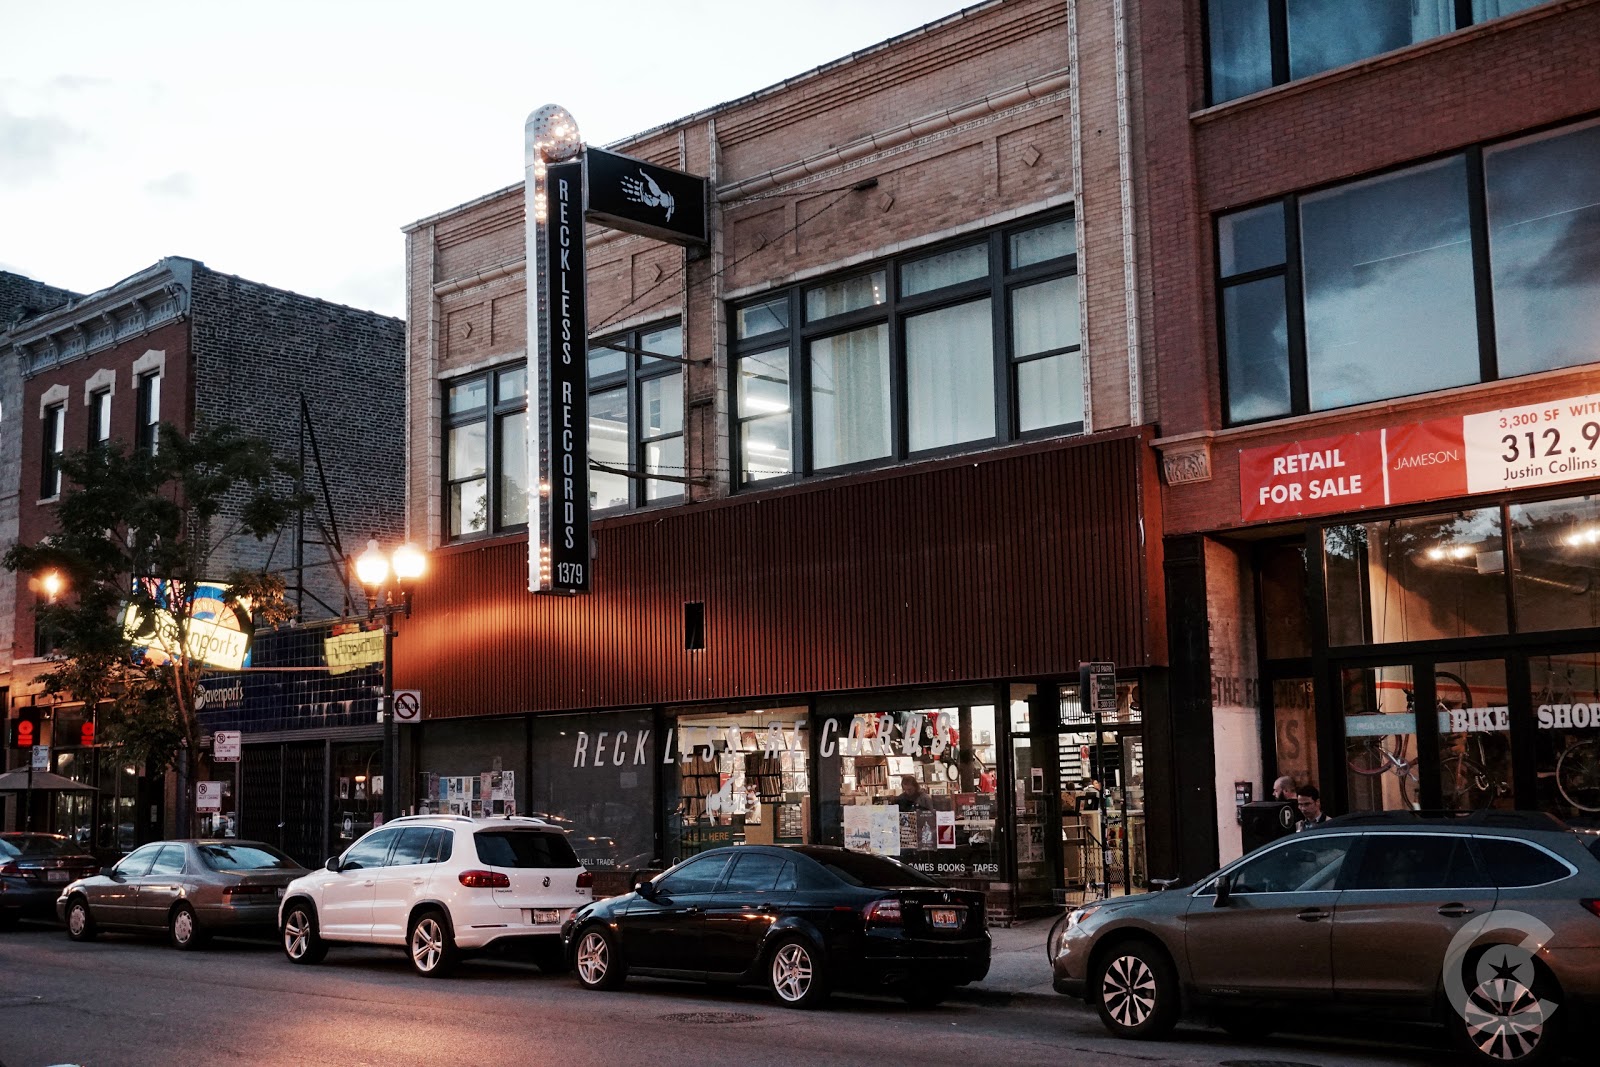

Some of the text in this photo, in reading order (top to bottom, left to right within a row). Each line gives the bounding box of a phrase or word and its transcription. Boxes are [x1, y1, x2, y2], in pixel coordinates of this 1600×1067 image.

[559, 179, 574, 549] RECKLESS RECORDS
[1499, 402, 1600, 429] 3,300 SF WIT
[1272, 449, 1345, 476] RETAIL
[1503, 456, 1598, 481] Justin Collins
[1259, 475, 1362, 505] FOR SALE
[557, 562, 583, 584] 1379
[1451, 706, 1510, 733] BIKE
[573, 711, 952, 769] RECKLESS RECORDS
[708, 831, 730, 842] HERE
[580, 858, 615, 866] SELL TRADE
[937, 863, 966, 872] BOOKS
[973, 863, 999, 872] TAPES
